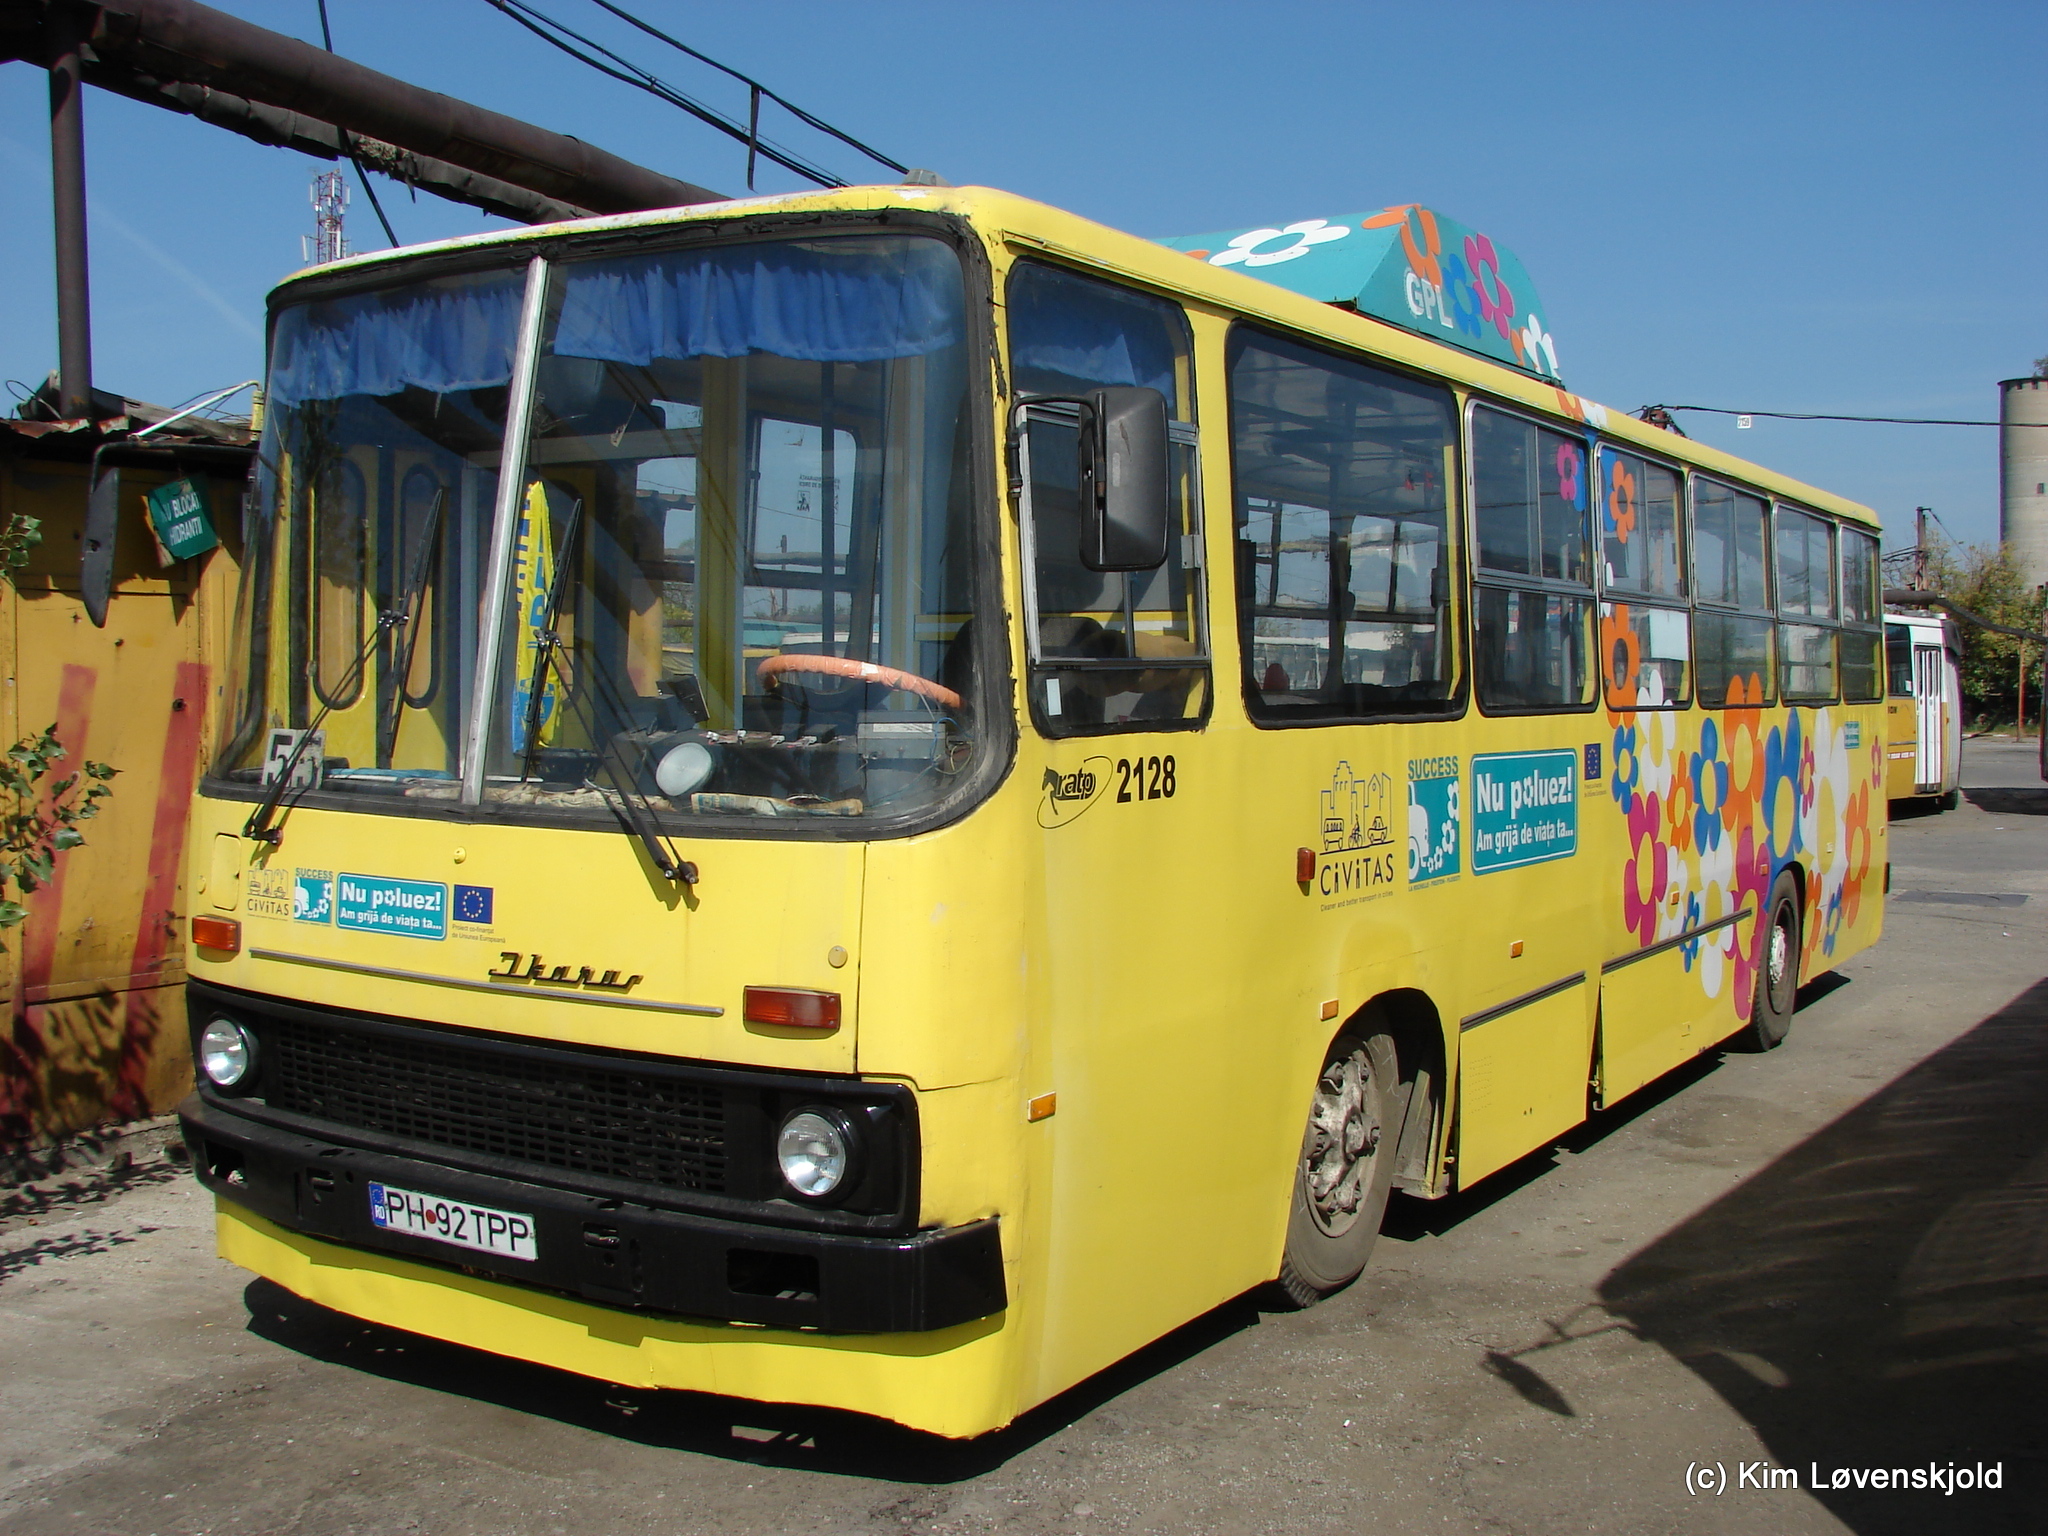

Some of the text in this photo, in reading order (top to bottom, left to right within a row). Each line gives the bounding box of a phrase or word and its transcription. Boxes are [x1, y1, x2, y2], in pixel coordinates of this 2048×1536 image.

[1405, 271, 1454, 329] GPL
[1056, 767, 1096, 800] ratp
[1116, 755, 1176, 803] 2128
[1408, 756, 1459, 780] SUCCESS
[1476, 773, 1504, 814] Nu
[1476, 829, 1493, 852] Am
[1520, 822, 1532, 845] de
[1557, 818, 1574, 838] ta...
[295, 867, 334, 881] SUCCESS
[342, 881, 366, 903] Nu
[340, 907, 355, 920] Am
[381, 912, 393, 924] de
[488, 951, 644, 991] Ikarus
[374, 1204, 385, 1219] RO
